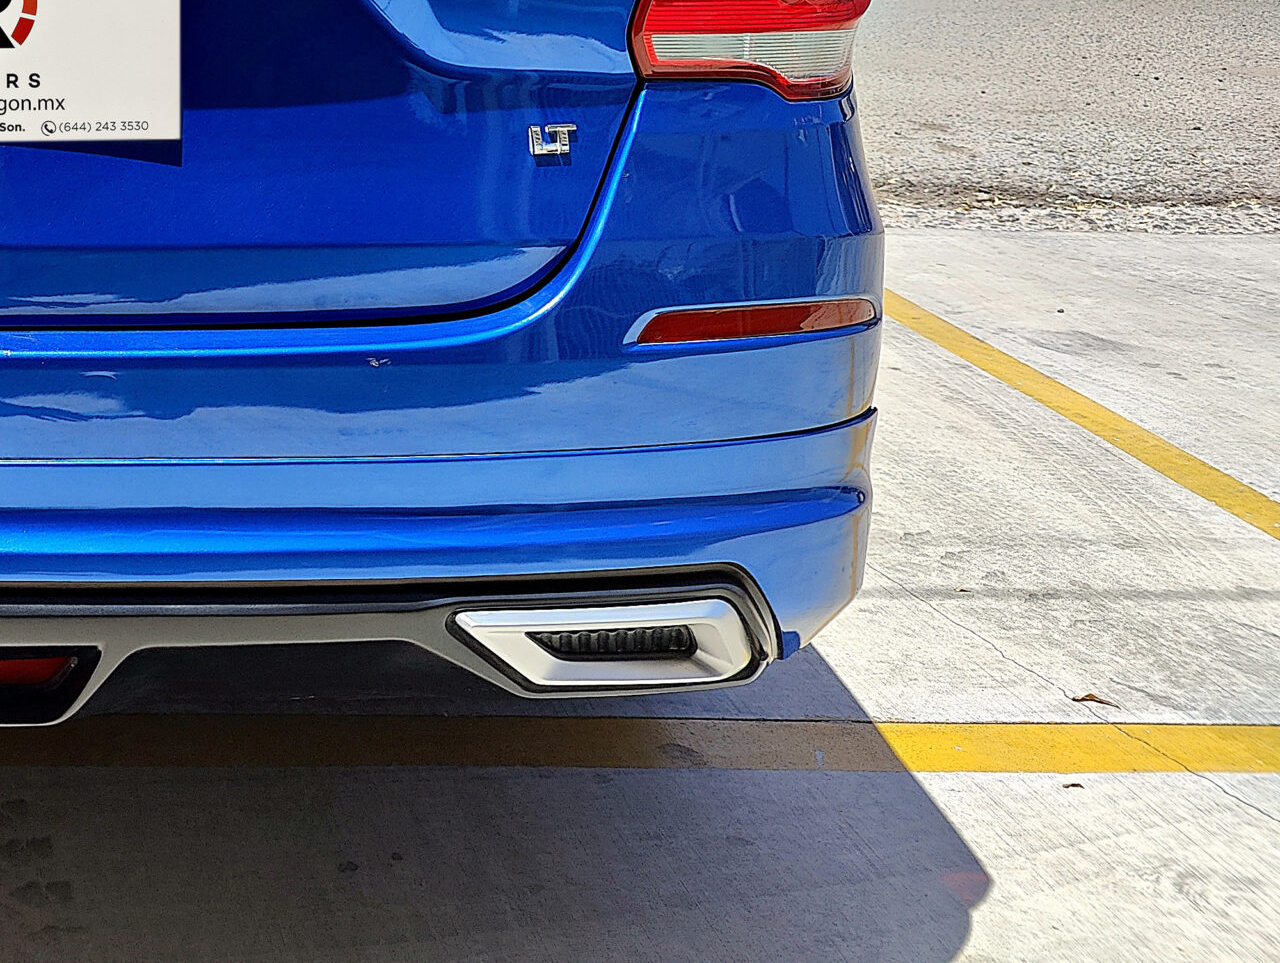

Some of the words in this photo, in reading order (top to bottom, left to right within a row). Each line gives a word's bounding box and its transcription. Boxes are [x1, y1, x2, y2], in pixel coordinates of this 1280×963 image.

[0, 122, 26, 133] Son.
[58, 121, 92, 134] (644)
[95, 121, 117, 132] 243
[120, 120, 149, 131] 3530
[528, 124, 578, 156] LT
